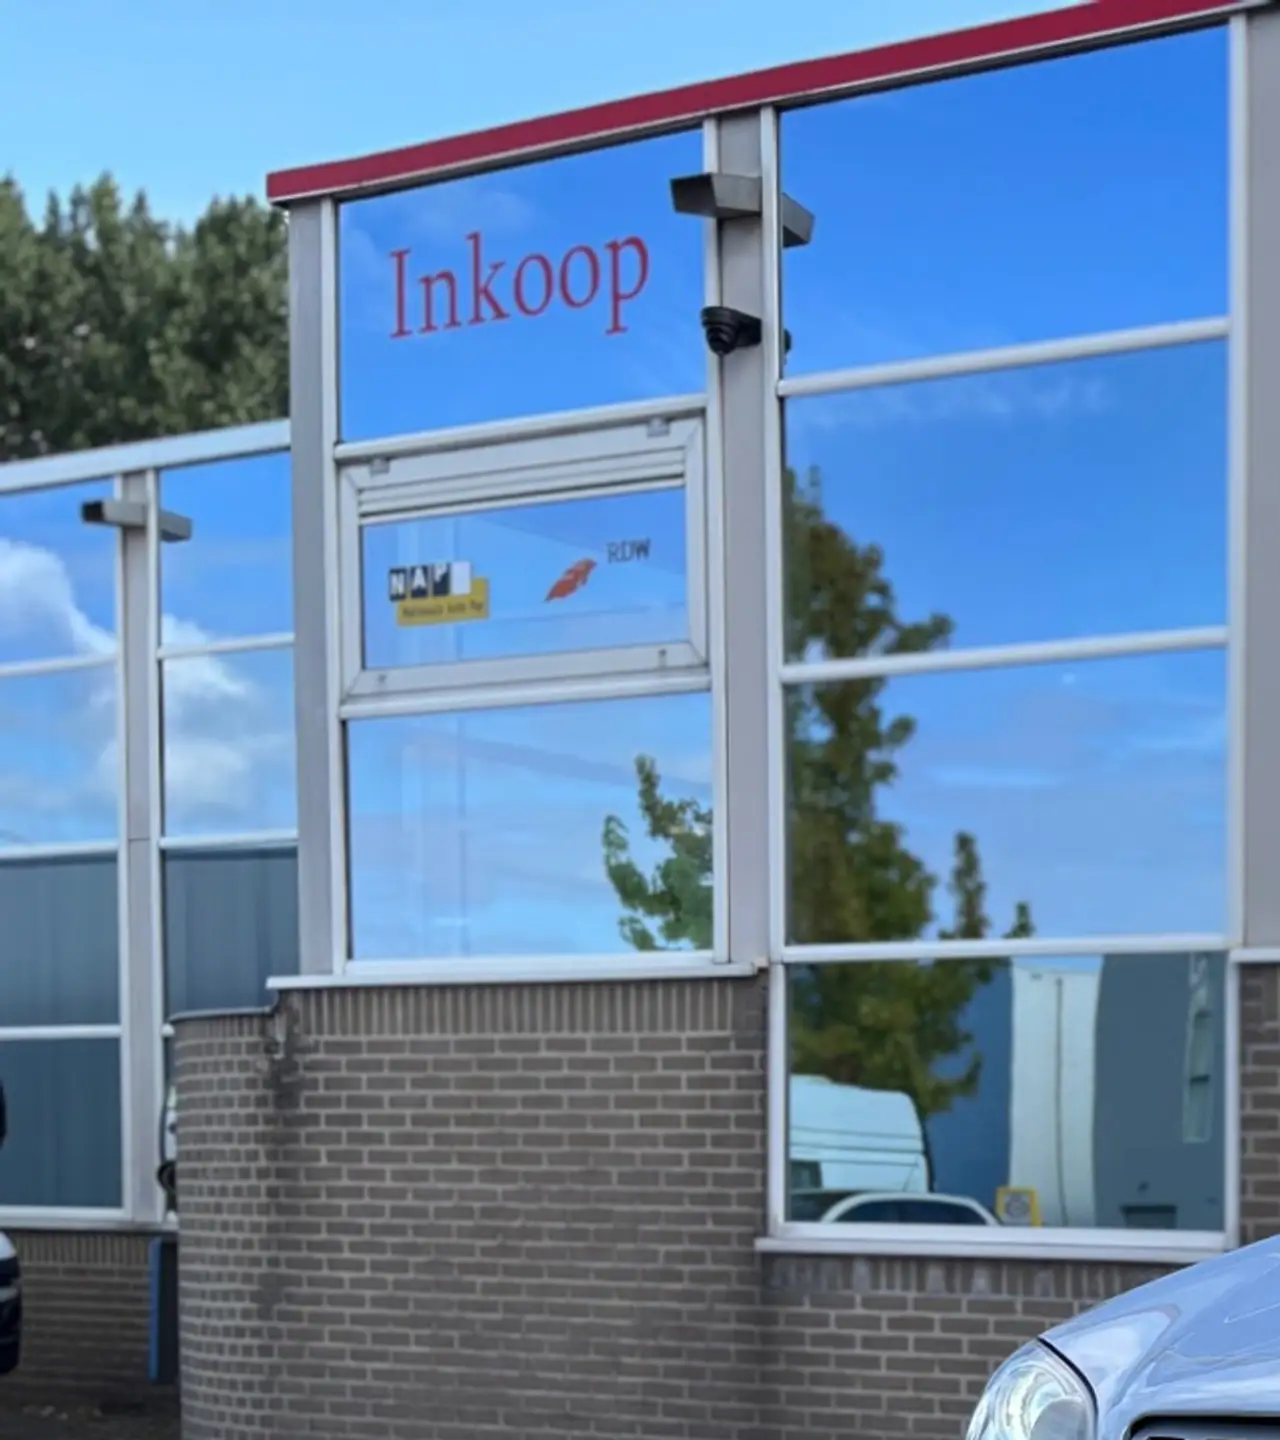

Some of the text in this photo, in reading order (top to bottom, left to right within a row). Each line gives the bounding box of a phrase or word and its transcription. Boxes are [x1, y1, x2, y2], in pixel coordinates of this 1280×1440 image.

[390, 232, 650, 338] Inkoop
[606, 539, 651, 565] RDW
[389, 562, 449, 600] NAP
